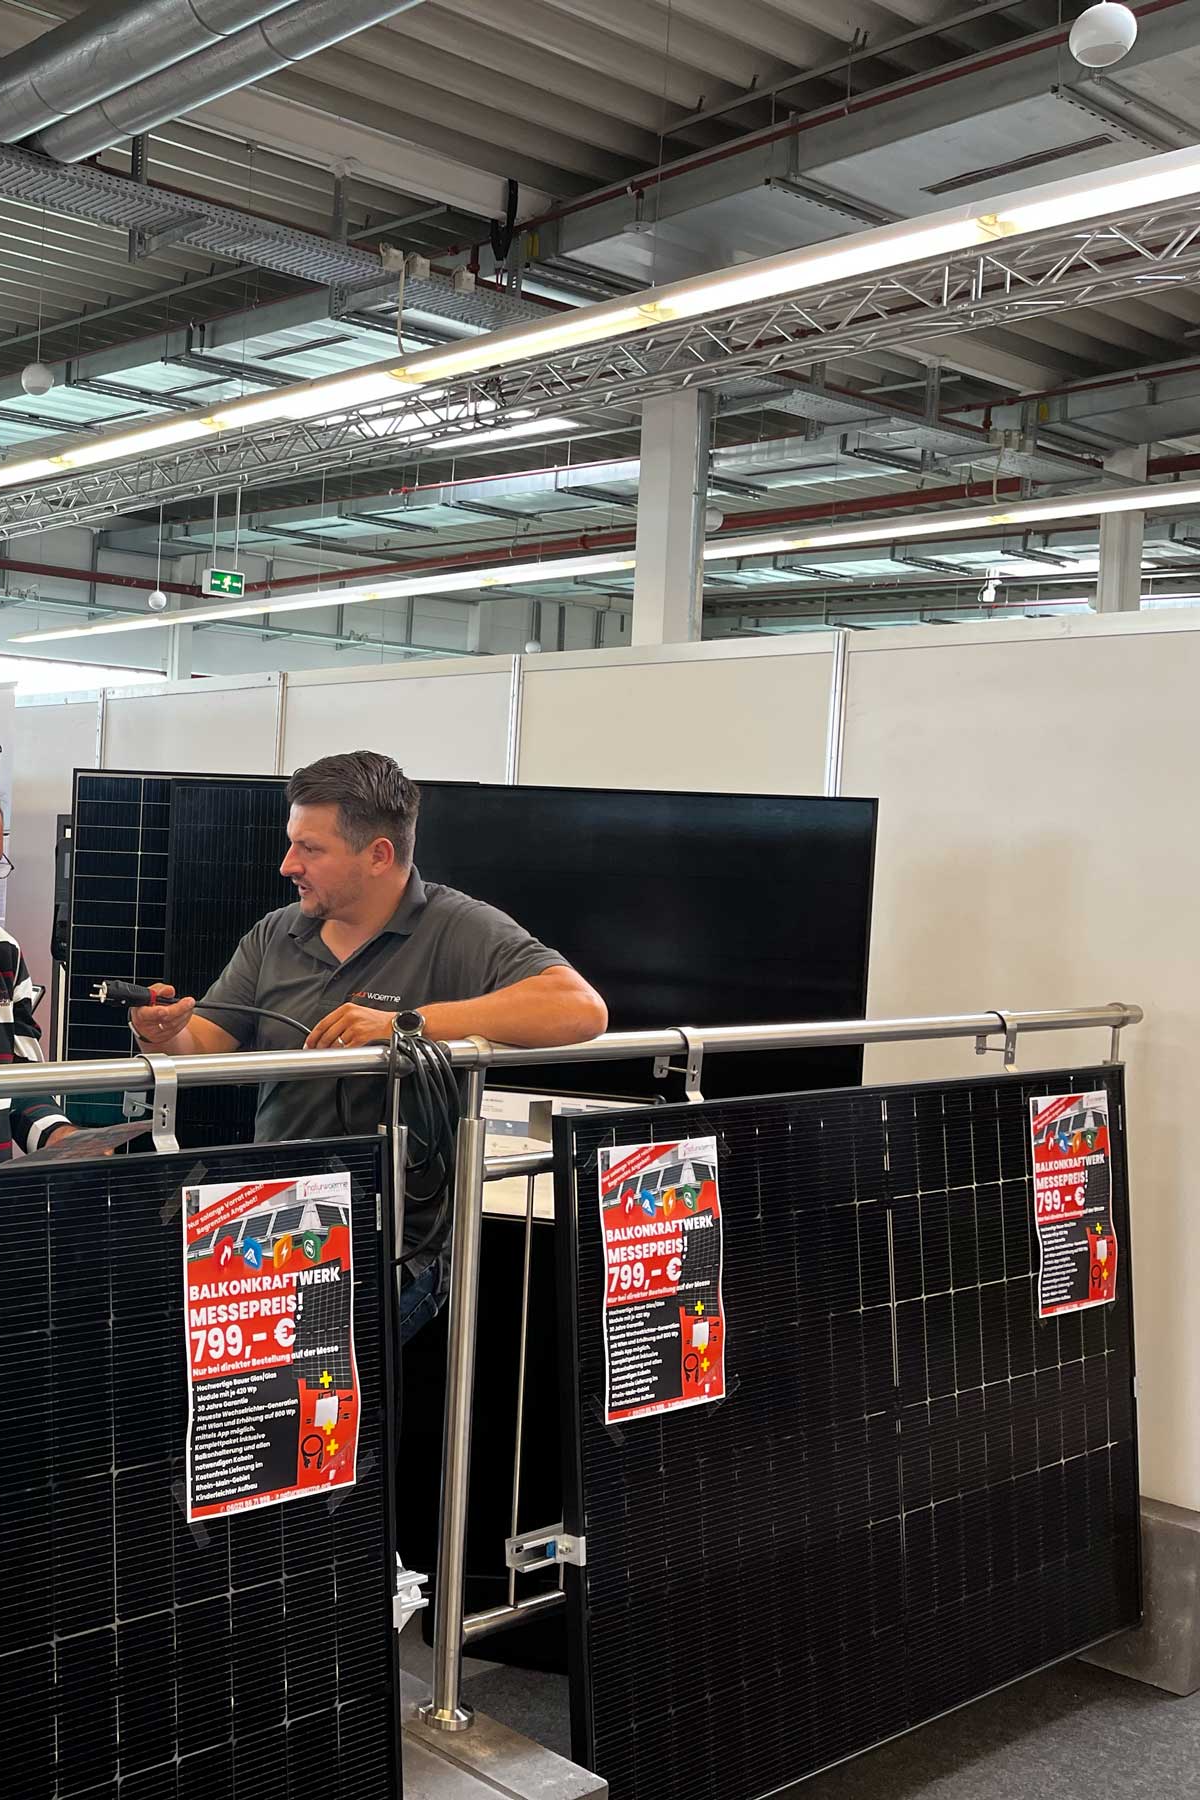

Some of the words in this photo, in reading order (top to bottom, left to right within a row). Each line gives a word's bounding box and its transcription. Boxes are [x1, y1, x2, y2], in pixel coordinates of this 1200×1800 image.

[1035, 1153, 1105, 1174] BALKONKRAFTWERK
[1036, 1169, 1089, 1190] MESSEPREIS!
[606, 1214, 714, 1243] BALKONKRAFTWERK
[608, 1236, 688, 1264] MESSEPREIS!
[189, 1266, 341, 1301] BALKONKRAFTWERK
[190, 1292, 304, 1328] MESSEPREIS!
